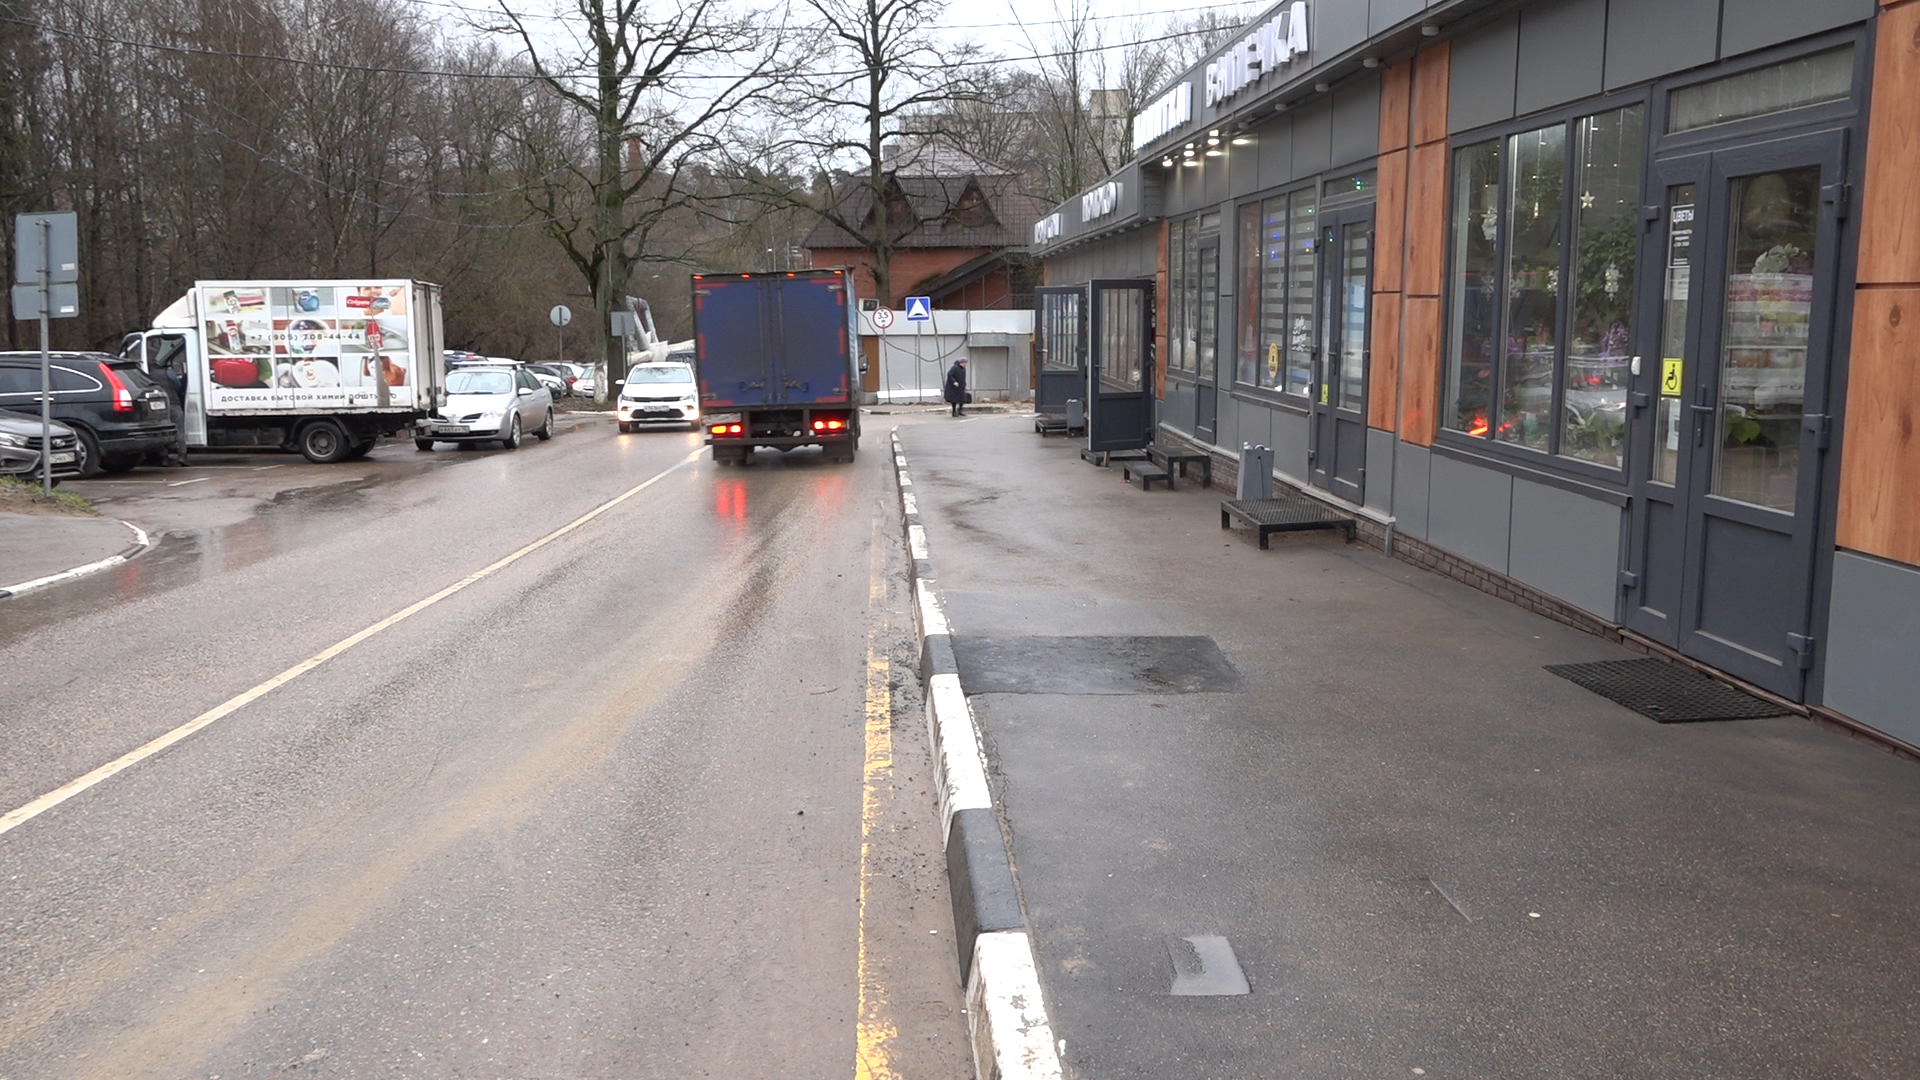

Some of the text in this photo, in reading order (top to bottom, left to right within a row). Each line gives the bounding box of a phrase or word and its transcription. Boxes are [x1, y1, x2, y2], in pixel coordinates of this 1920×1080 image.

[1206, 1, 1308, 108] ВЫПЕЧКА
[1673, 209, 1694, 223] ЦВЕТЫ
[346, 298, 370, 307] Colgate
[268, 333, 298, 341] (905)
[303, 333, 360, 341] 708-44-44
[221, 394, 268, 402] ДОСТАВКА
[271, 392, 313, 401] БЫТОВОЙ
